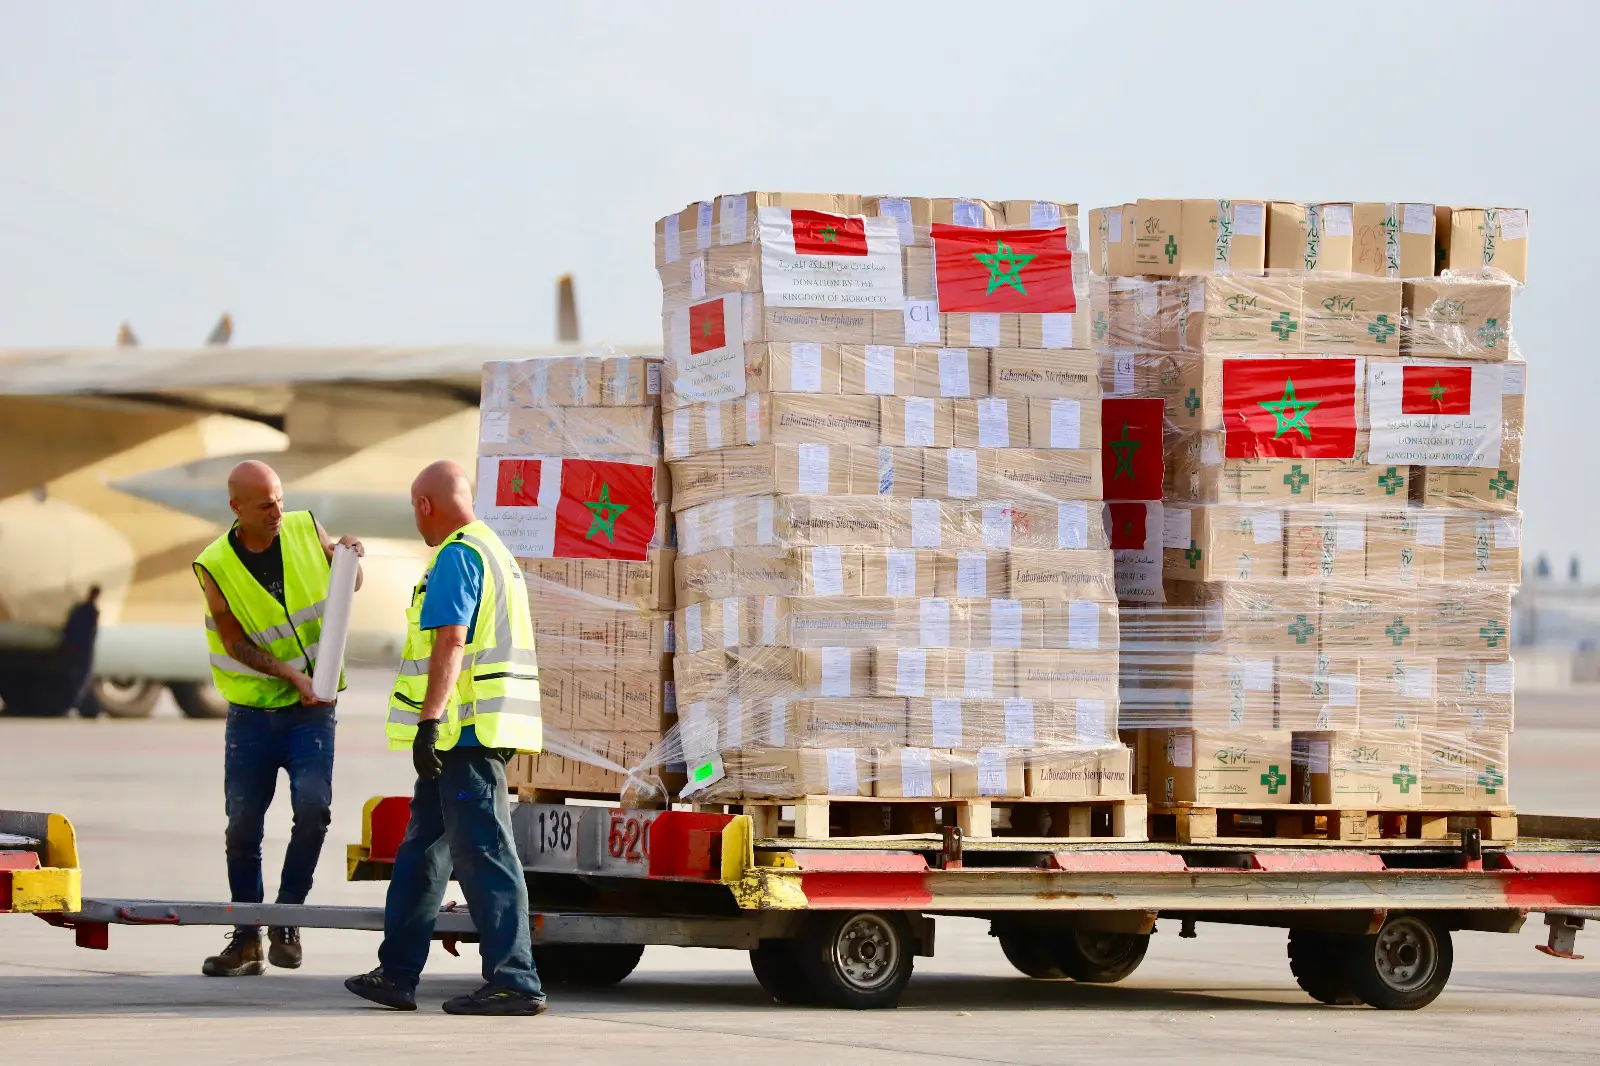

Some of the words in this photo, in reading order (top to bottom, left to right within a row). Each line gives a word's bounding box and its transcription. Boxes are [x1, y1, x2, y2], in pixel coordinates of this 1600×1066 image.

[793, 278, 840, 287] DONATION
[842, 279, 853, 287] BY
[855, 279, 874, 288] THE
[782, 292, 825, 301] KINGDOM
[827, 294, 839, 302] OF
[841, 294, 887, 303] MOROCCO
[773, 311, 818, 324] Laboratoires
[820, 312, 864, 328] Steripharma
[909, 305, 933, 322] C1
[1000, 368, 1043, 382] Laboratoires
[1044, 370, 1088, 385] Steripharma
[780, 413, 825, 427] Laboratoires
[827, 414, 872, 431] Steripharma
[1441, 422, 1451, 430] من
[1453, 420, 1487, 430] مساعدات
[1398, 437, 1443, 446] DONATION
[1445, 437, 1455, 446] BY
[1458, 438, 1474, 446] THE
[1385, 451, 1427, 460] KINGDOM
[1429, 452, 1440, 460] OF
[1441, 452, 1485, 461] MOROCCO
[1004, 469, 1046, 482] Laboratoires
[1048, 471, 1092, 486] Steripharma
[789, 516, 835, 529] Laboratoires
[1016, 570, 1060, 584] Laboratoires
[1060, 571, 1105, 586] Steripharma
[795, 616, 841, 629] Laboratoires
[843, 616, 888, 631] Steripharma
[1027, 668, 1070, 682] Laboratoires
[1070, 669, 1112, 685] Steripharma
[1040, 767, 1082, 781] Laboratoires
[1083, 766, 1125, 782] Steripharma
[538, 809, 572, 854] 138
